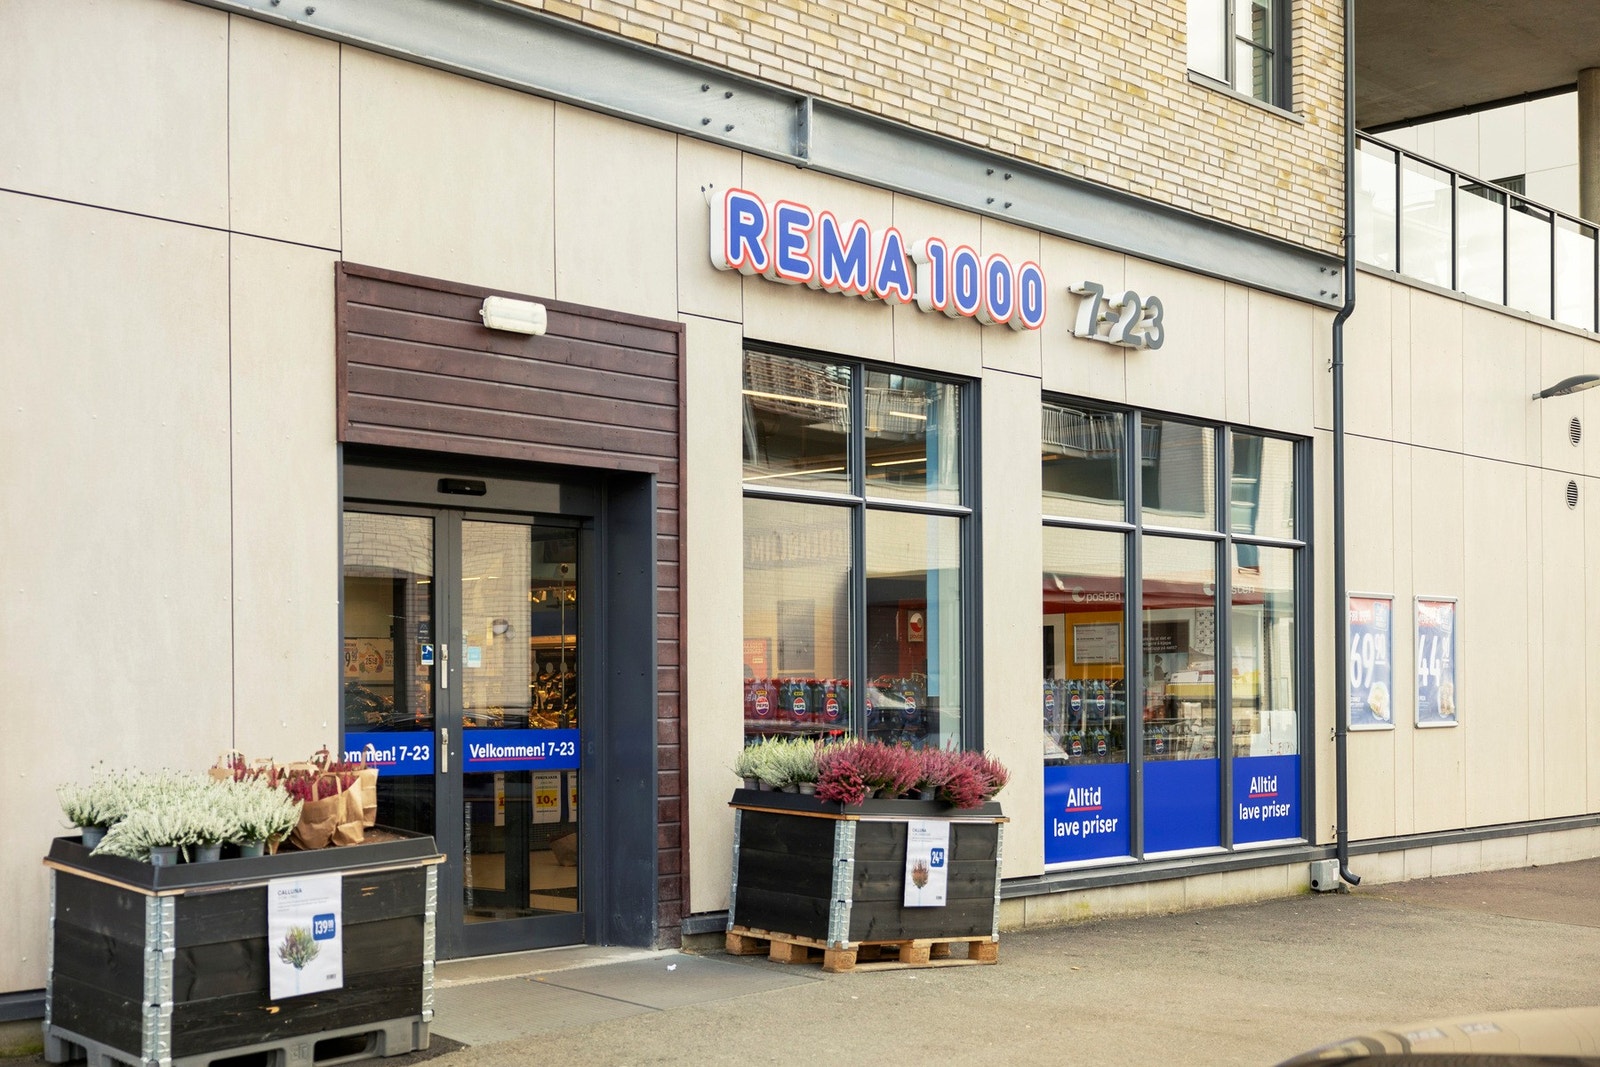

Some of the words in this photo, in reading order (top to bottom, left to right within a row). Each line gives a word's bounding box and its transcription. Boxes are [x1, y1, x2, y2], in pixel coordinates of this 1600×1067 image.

[724, 187, 914, 304] REMA
[926, 236, 1047, 331] 1000
[1070, 280, 1165, 351] 7-23
[1085, 589, 1121, 603] posten
[1231, 584, 1255, 595] sten
[1350, 632, 1375, 688] 69
[1418, 634, 1440, 687] 44
[399, 745, 430, 761] 7-23
[469, 742, 545, 759] Velkommen!
[548, 742, 575, 756] 7-23
[1250, 776, 1277, 793] Alltid
[1067, 787, 1101, 807] Alltid
[1239, 803, 1260, 820] lave
[1262, 800, 1290, 821] priser
[1054, 818, 1079, 837] lave
[1083, 815, 1118, 838] priser
[277, 888, 302, 896] CALLUNA
[315, 920, 327, 935] 139
